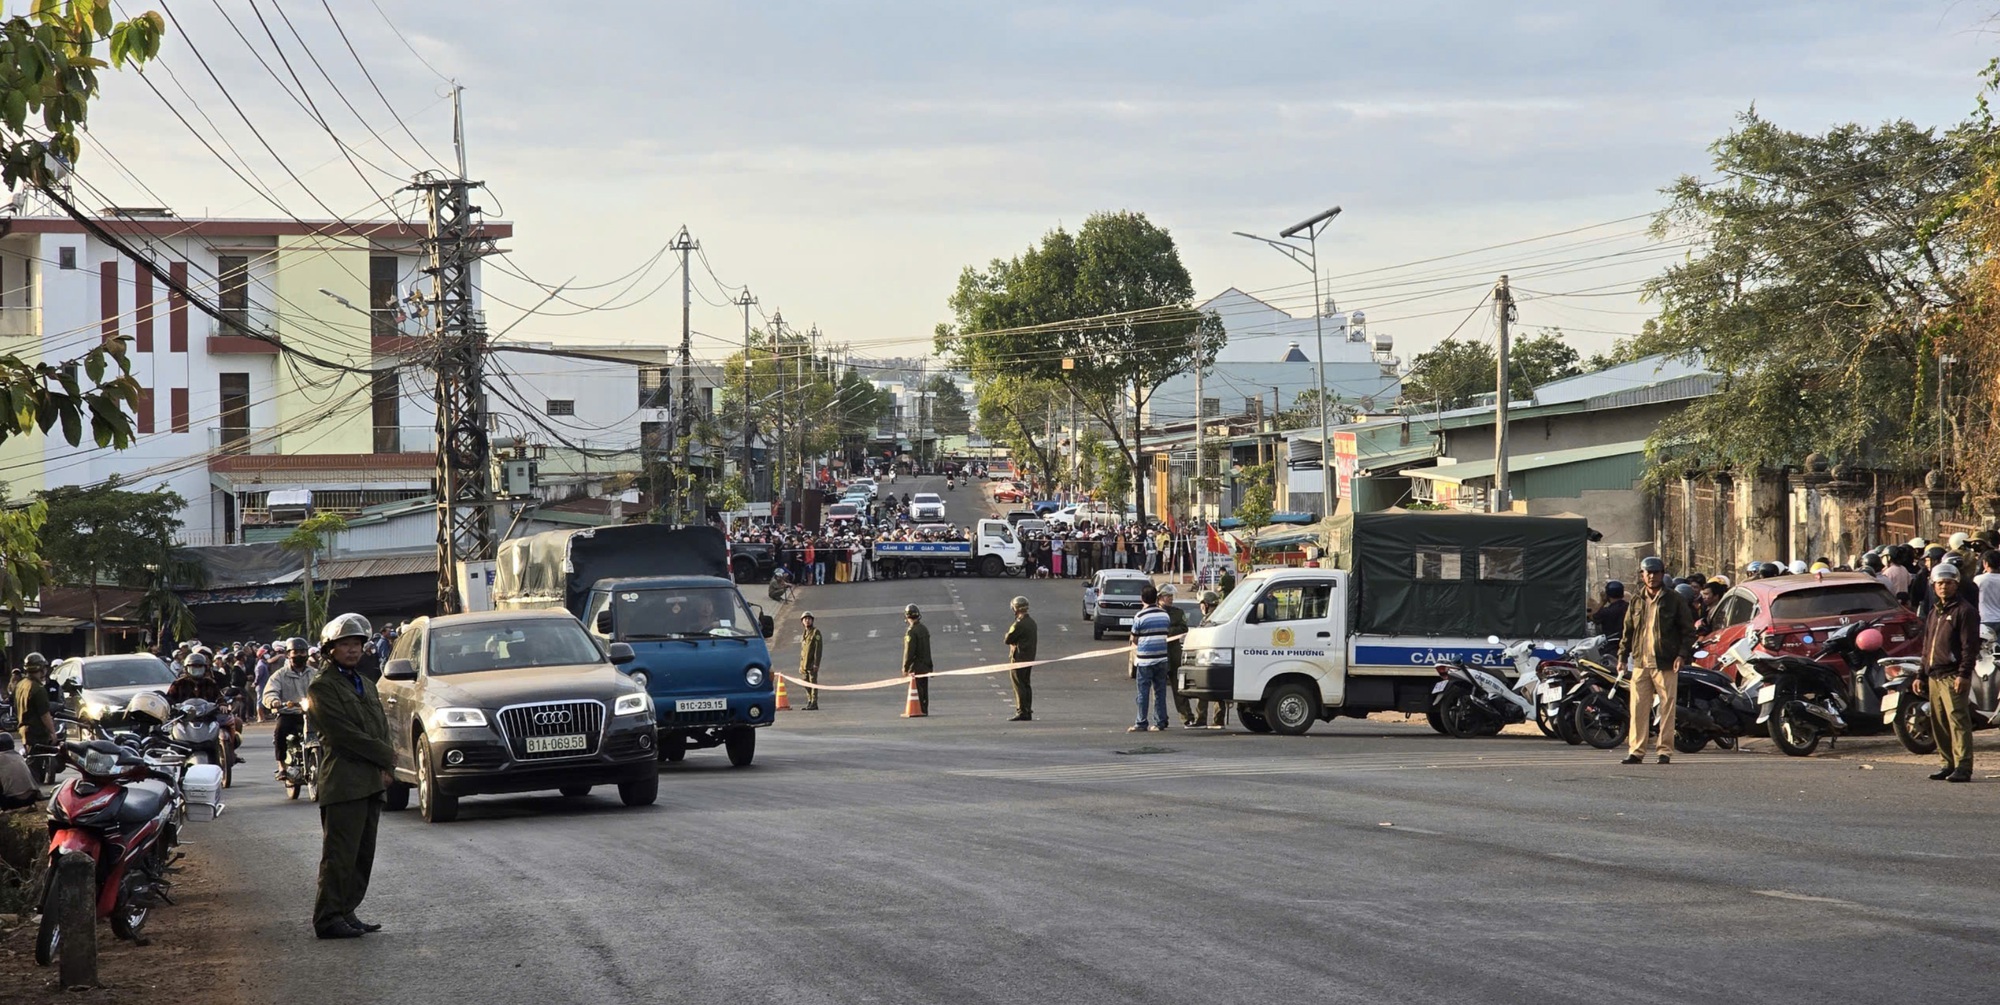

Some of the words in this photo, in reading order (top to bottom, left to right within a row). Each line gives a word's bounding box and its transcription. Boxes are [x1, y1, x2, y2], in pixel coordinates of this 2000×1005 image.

[1243, 648, 1269, 656] CÔNG
[1287, 648, 1325, 656] PHƯỜNG
[680, 698, 723, 710] 81C-239.15
[528, 734, 584, 750] 81A-069.58
